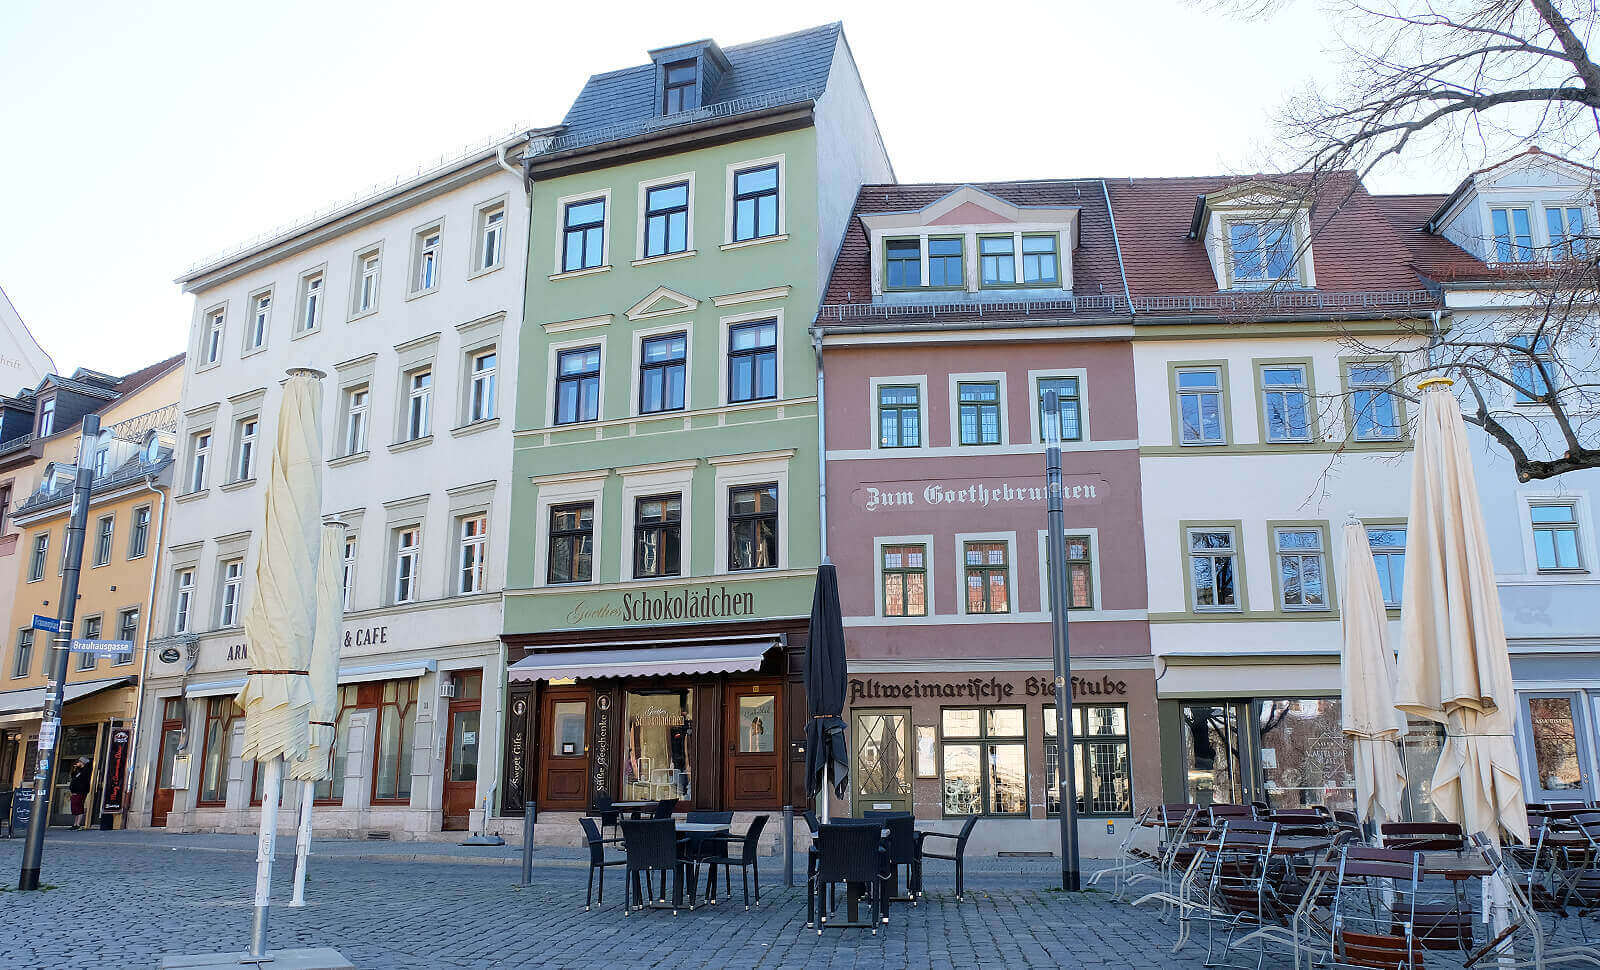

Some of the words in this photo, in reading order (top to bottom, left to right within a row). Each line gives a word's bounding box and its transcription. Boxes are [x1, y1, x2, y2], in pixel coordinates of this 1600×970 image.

[865, 487, 914, 511] Zum
[566, 600, 623, 625] Goethes
[622, 586, 754, 622] Schokolädchen
[73, 641, 129, 652] Brauhausgasse
[227, 643, 248, 661] ARN
[343, 630, 352, 648] &
[355, 626, 388, 646] CAFE
[1025, 675, 1127, 700] Biestube
